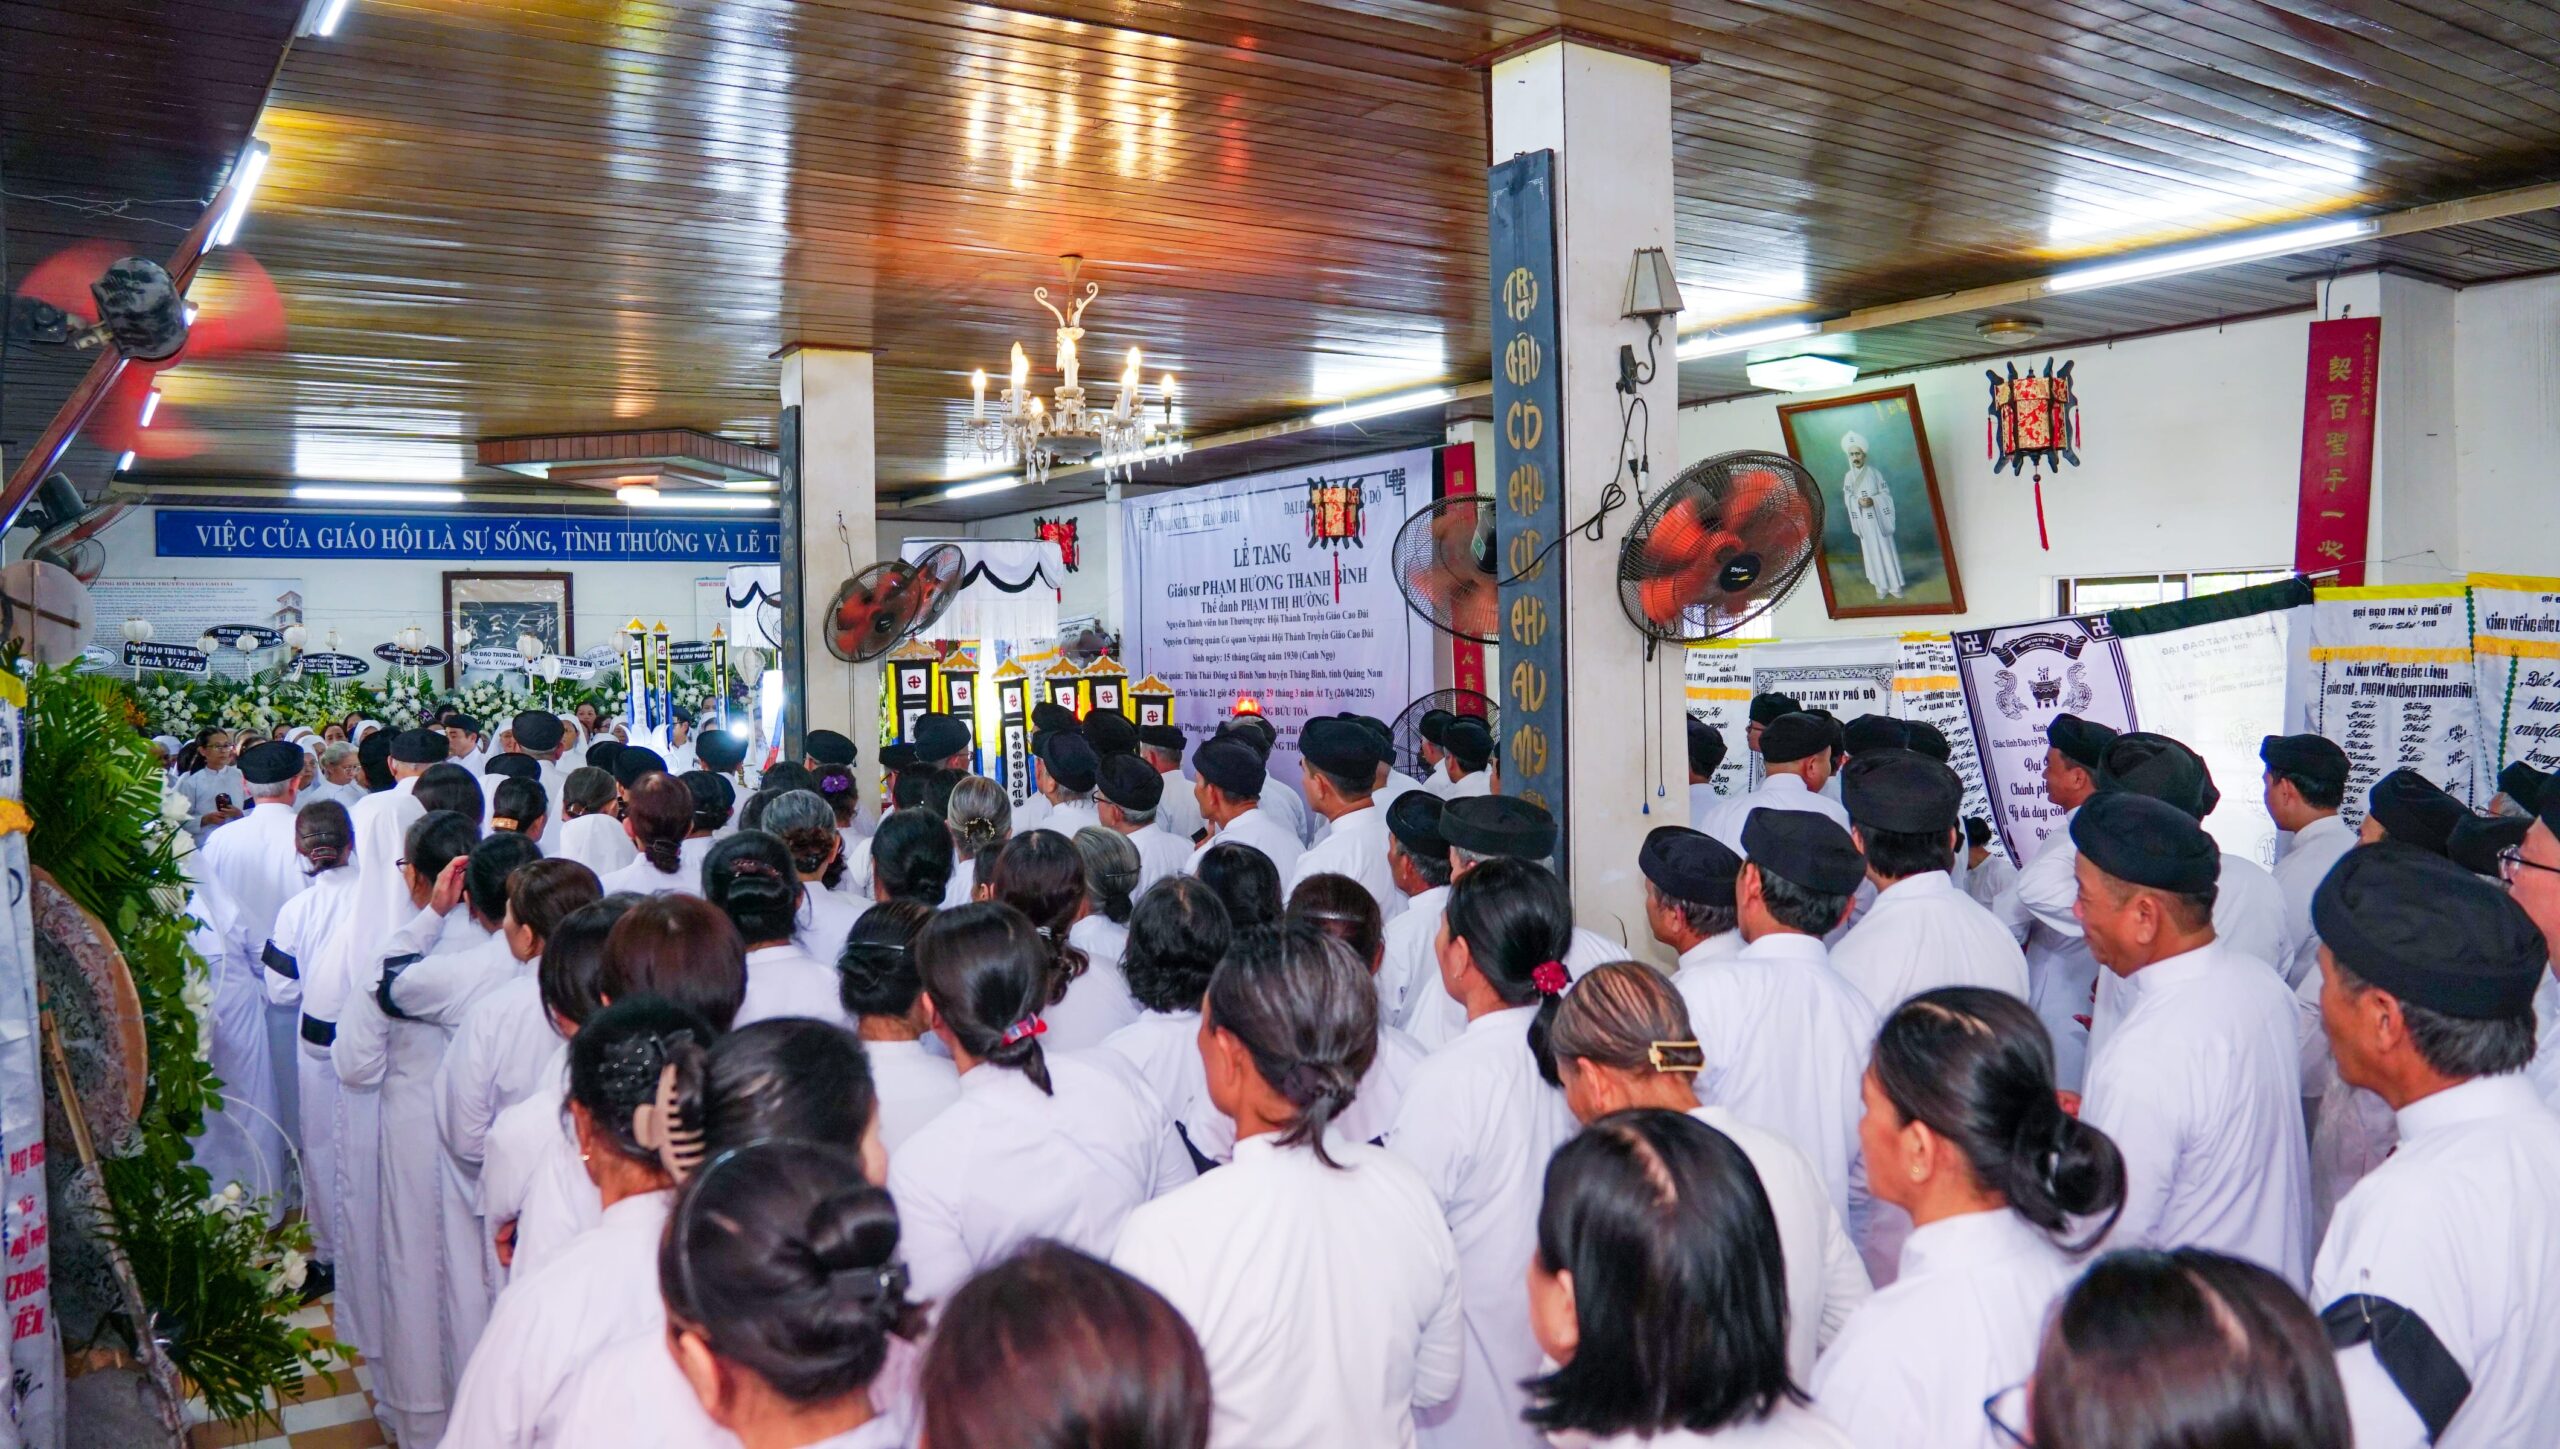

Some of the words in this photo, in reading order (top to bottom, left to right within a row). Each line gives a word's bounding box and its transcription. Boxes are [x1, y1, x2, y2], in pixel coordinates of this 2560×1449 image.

[195, 519, 255, 551] VIỆC
[262, 519, 311, 548] CỦA
[317, 521, 375, 549] GIÁO
[382, 523, 422, 553] HỘI
[428, 523, 456, 550] LÀ
[463, 526, 490, 554] SỰ
[494, 521, 557, 554] SỐNG,
[562, 526, 611, 552] TÌNH
[617, 529, 699, 553] THƯƠNG
[704, 528, 730, 553] VÀ
[736, 529, 761, 553] LẼ
[1253, 543, 1291, 567] TANG
[1167, 582, 1188, 599] Giáo
[1190, 582, 1200, 596] sư
[1202, 578, 1236, 598] PHẠM
[1240, 573, 1284, 594] HƯƠNG
[1287, 570, 1331, 588] THANH
[1335, 563, 1368, 584] BÌNH
[1201, 598, 1217, 614] Thế
[1219, 601, 1238, 613] danh
[1241, 597, 1269, 614] PHẠM
[1271, 596, 1289, 612] THỊ
[1292, 590, 1329, 609] HƯỜNG
[1267, 614, 1279, 626] Hội
[1281, 613, 1301, 623] Thánh
[1303, 609, 1325, 623] Truyền
[1326, 610, 1341, 621] Giáo
[1342, 610, 1356, 619] Cao
[1357, 608, 1369, 619] Đài
[2369, 607, 2386, 618] ĐẠO
[2388, 607, 2405, 616] TAM
[2485, 612, 2507, 631] KÍNH
[2509, 613, 2537, 633] VIẾNG
[1271, 632, 1284, 644] Hội
[1285, 631, 1306, 641] Thánh
[1307, 627, 1329, 642] Truyền
[1330, 630, 1346, 640] Giáo
[1347, 629, 1361, 639] Cao
[1361, 628, 1374, 638] Đài
[1267, 651, 1282, 661] năm
[1284, 650, 1298, 661] 1930
[1299, 649, 1319, 661] (Canh
[166, 657, 204, 672] Viếng
[2345, 661, 2370, 677] KÍNH
[2372, 662, 2400, 679] VIẾNG
[2401, 663, 2423, 679] GIÁC
[2424, 665, 2449, 680] LINH
[1238, 670, 1253, 680] Bình
[1254, 670, 1267, 680] Nam
[1343, 667, 1365, 680] Quảng
[1367, 667, 1383, 678] Nam
[1209, 688, 1216, 697] 21
[1228, 688, 1236, 697] 45
[1266, 688, 1274, 698] 29
[1334, 688, 1375, 700] (26/04/2025)
[1809, 690, 1827, 701] TAM
[1843, 686, 1859, 701] PHỔ
[1863, 687, 1876, 702] ĐỘ
[2361, 682, 2385, 699] PHẠM
[2387, 682, 2418, 699] HƯƠNG
[2418, 684, 2453, 699] THANH
[2050, 804, 2067, 816] côn
